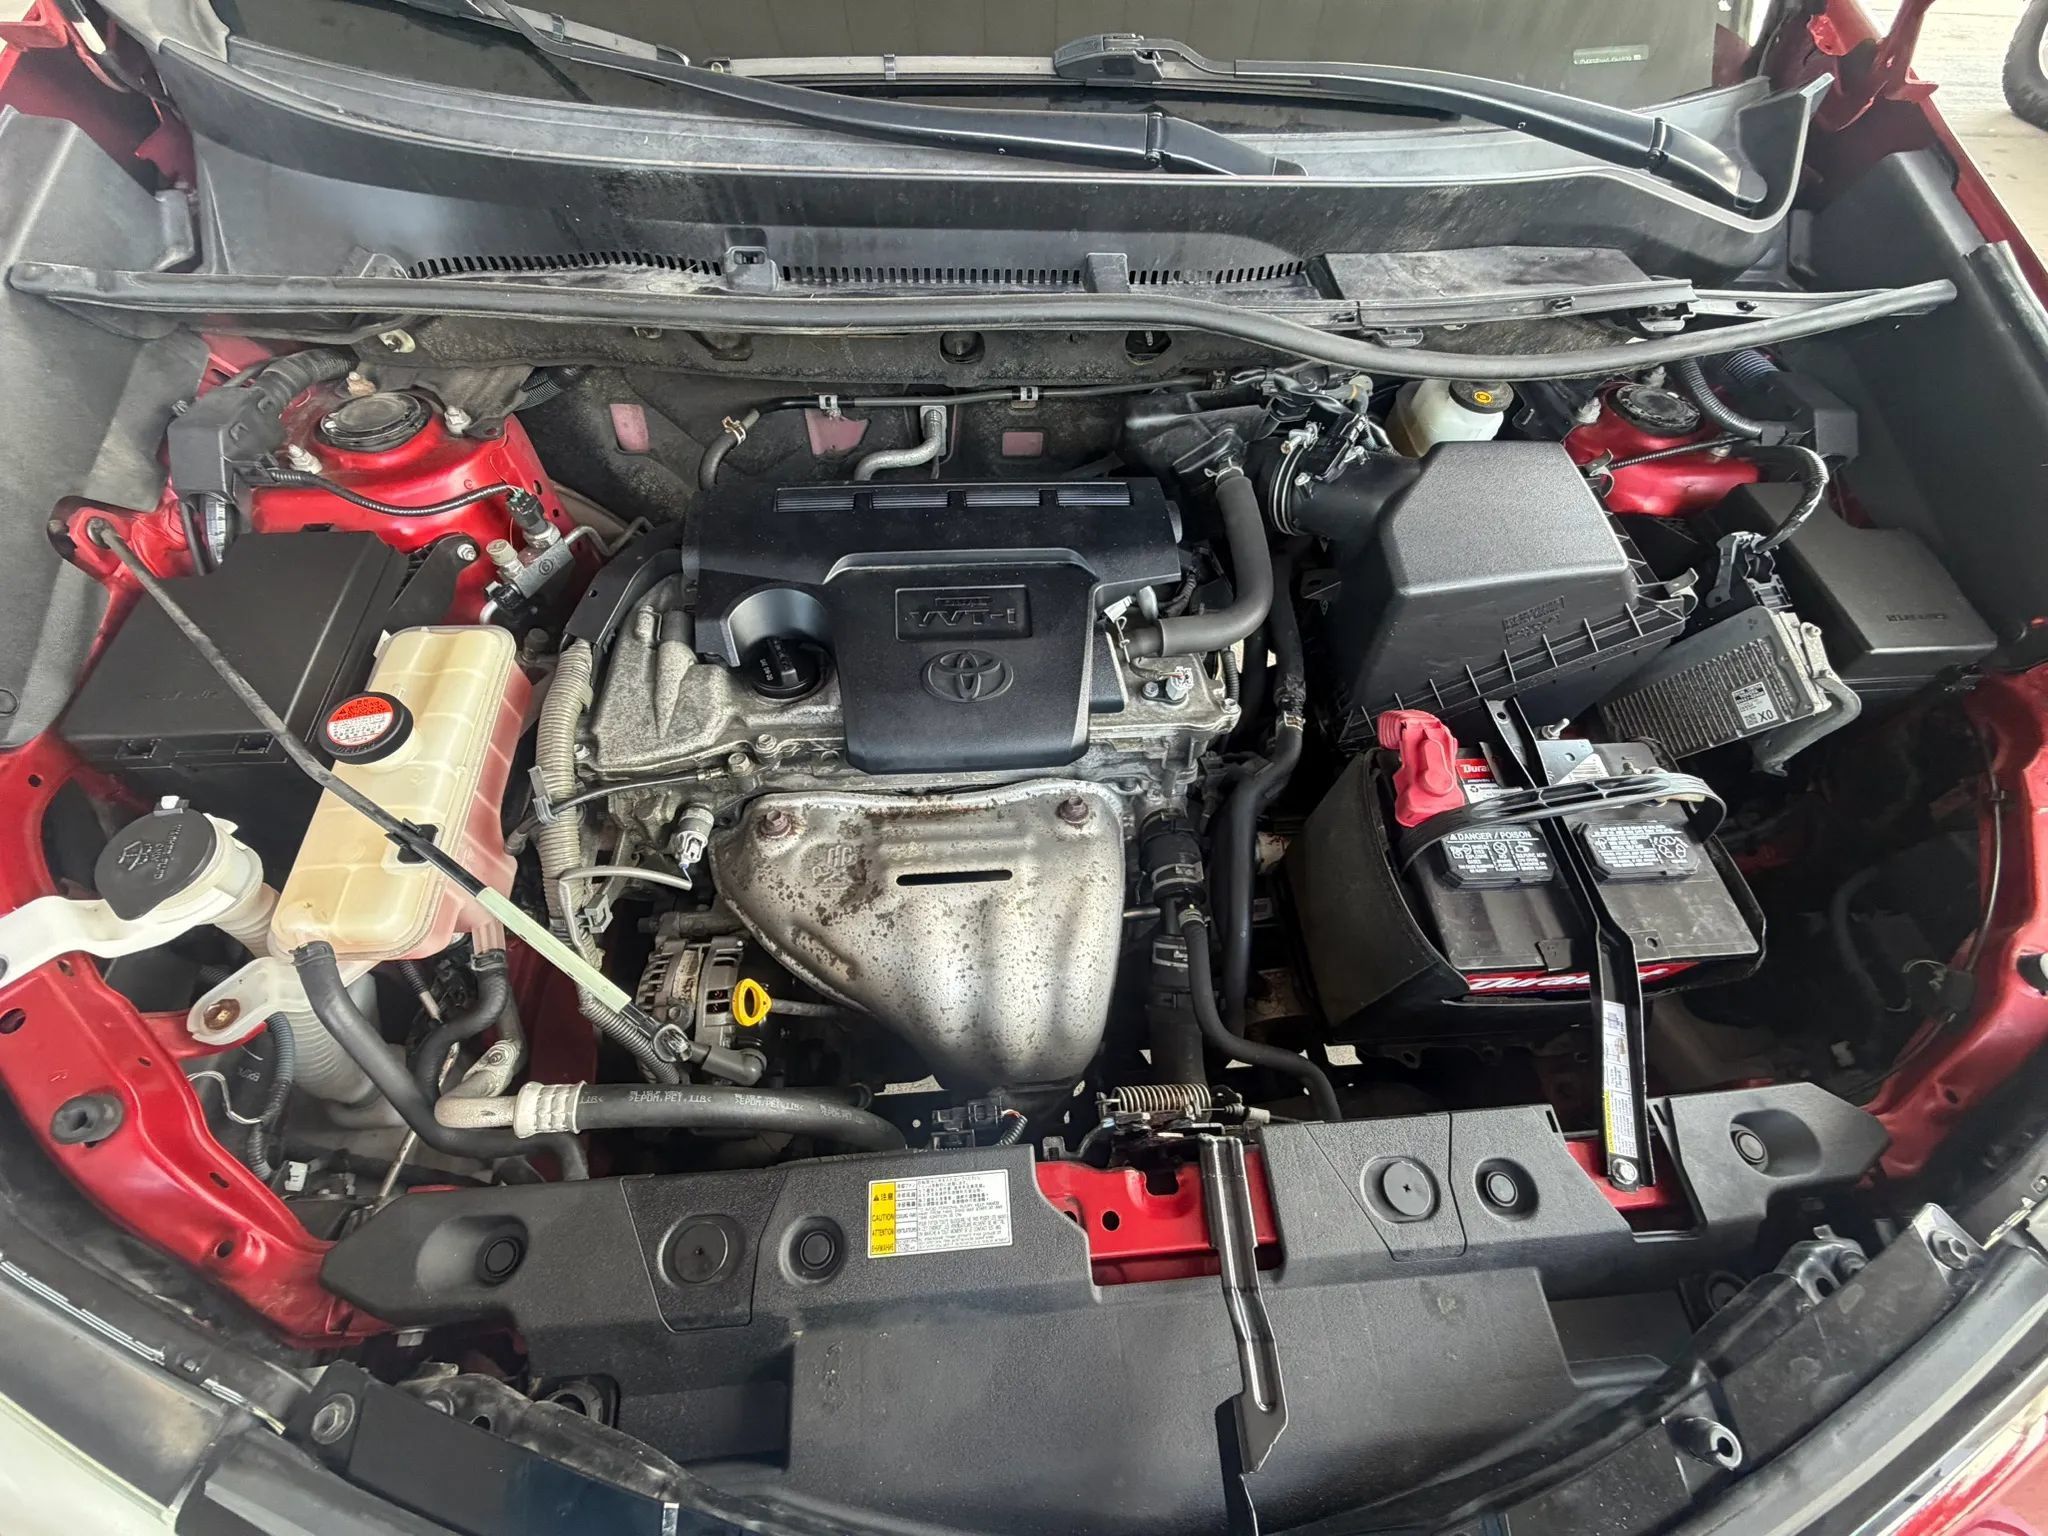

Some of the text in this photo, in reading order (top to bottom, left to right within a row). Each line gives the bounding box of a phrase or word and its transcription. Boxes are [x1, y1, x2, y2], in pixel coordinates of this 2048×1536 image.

[1457, 832, 1492, 841] DANGER
[1500, 831, 1532, 839] POISON
[872, 1213, 895, 1222] CAUTION
